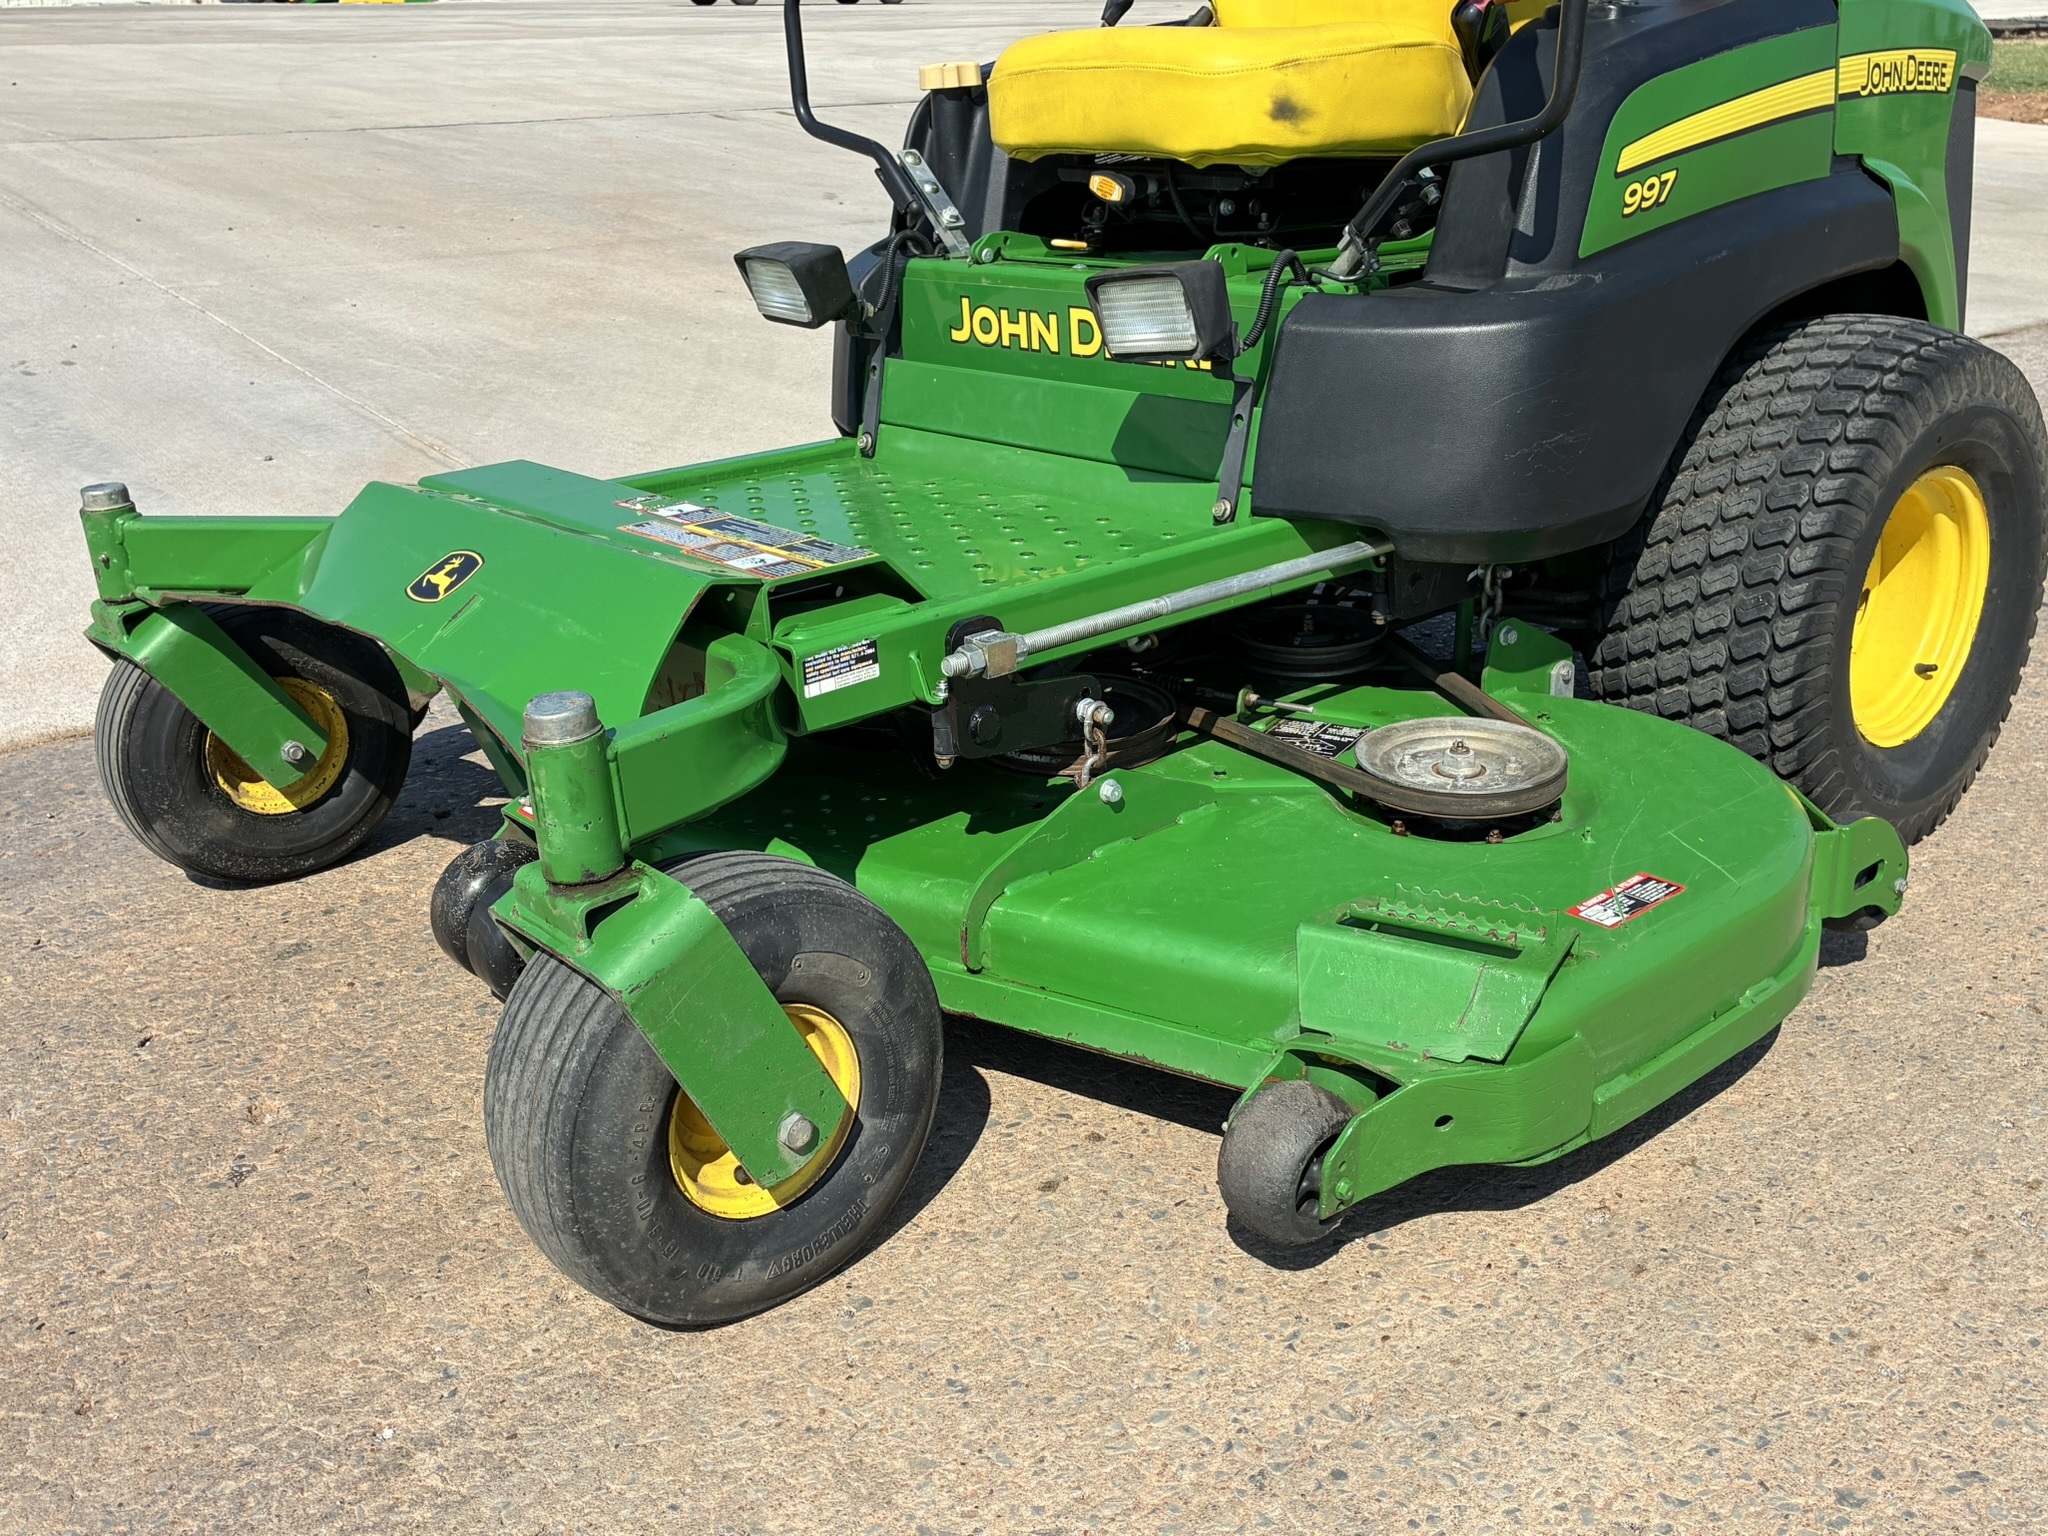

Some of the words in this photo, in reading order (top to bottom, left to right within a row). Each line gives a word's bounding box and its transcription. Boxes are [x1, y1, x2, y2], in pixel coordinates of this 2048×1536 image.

[1860, 58, 1904, 96] JOHN
[1906, 54, 1948, 92] DEERE
[1622, 168, 1678, 218] 997
[950, 295, 1060, 355] JOHN
